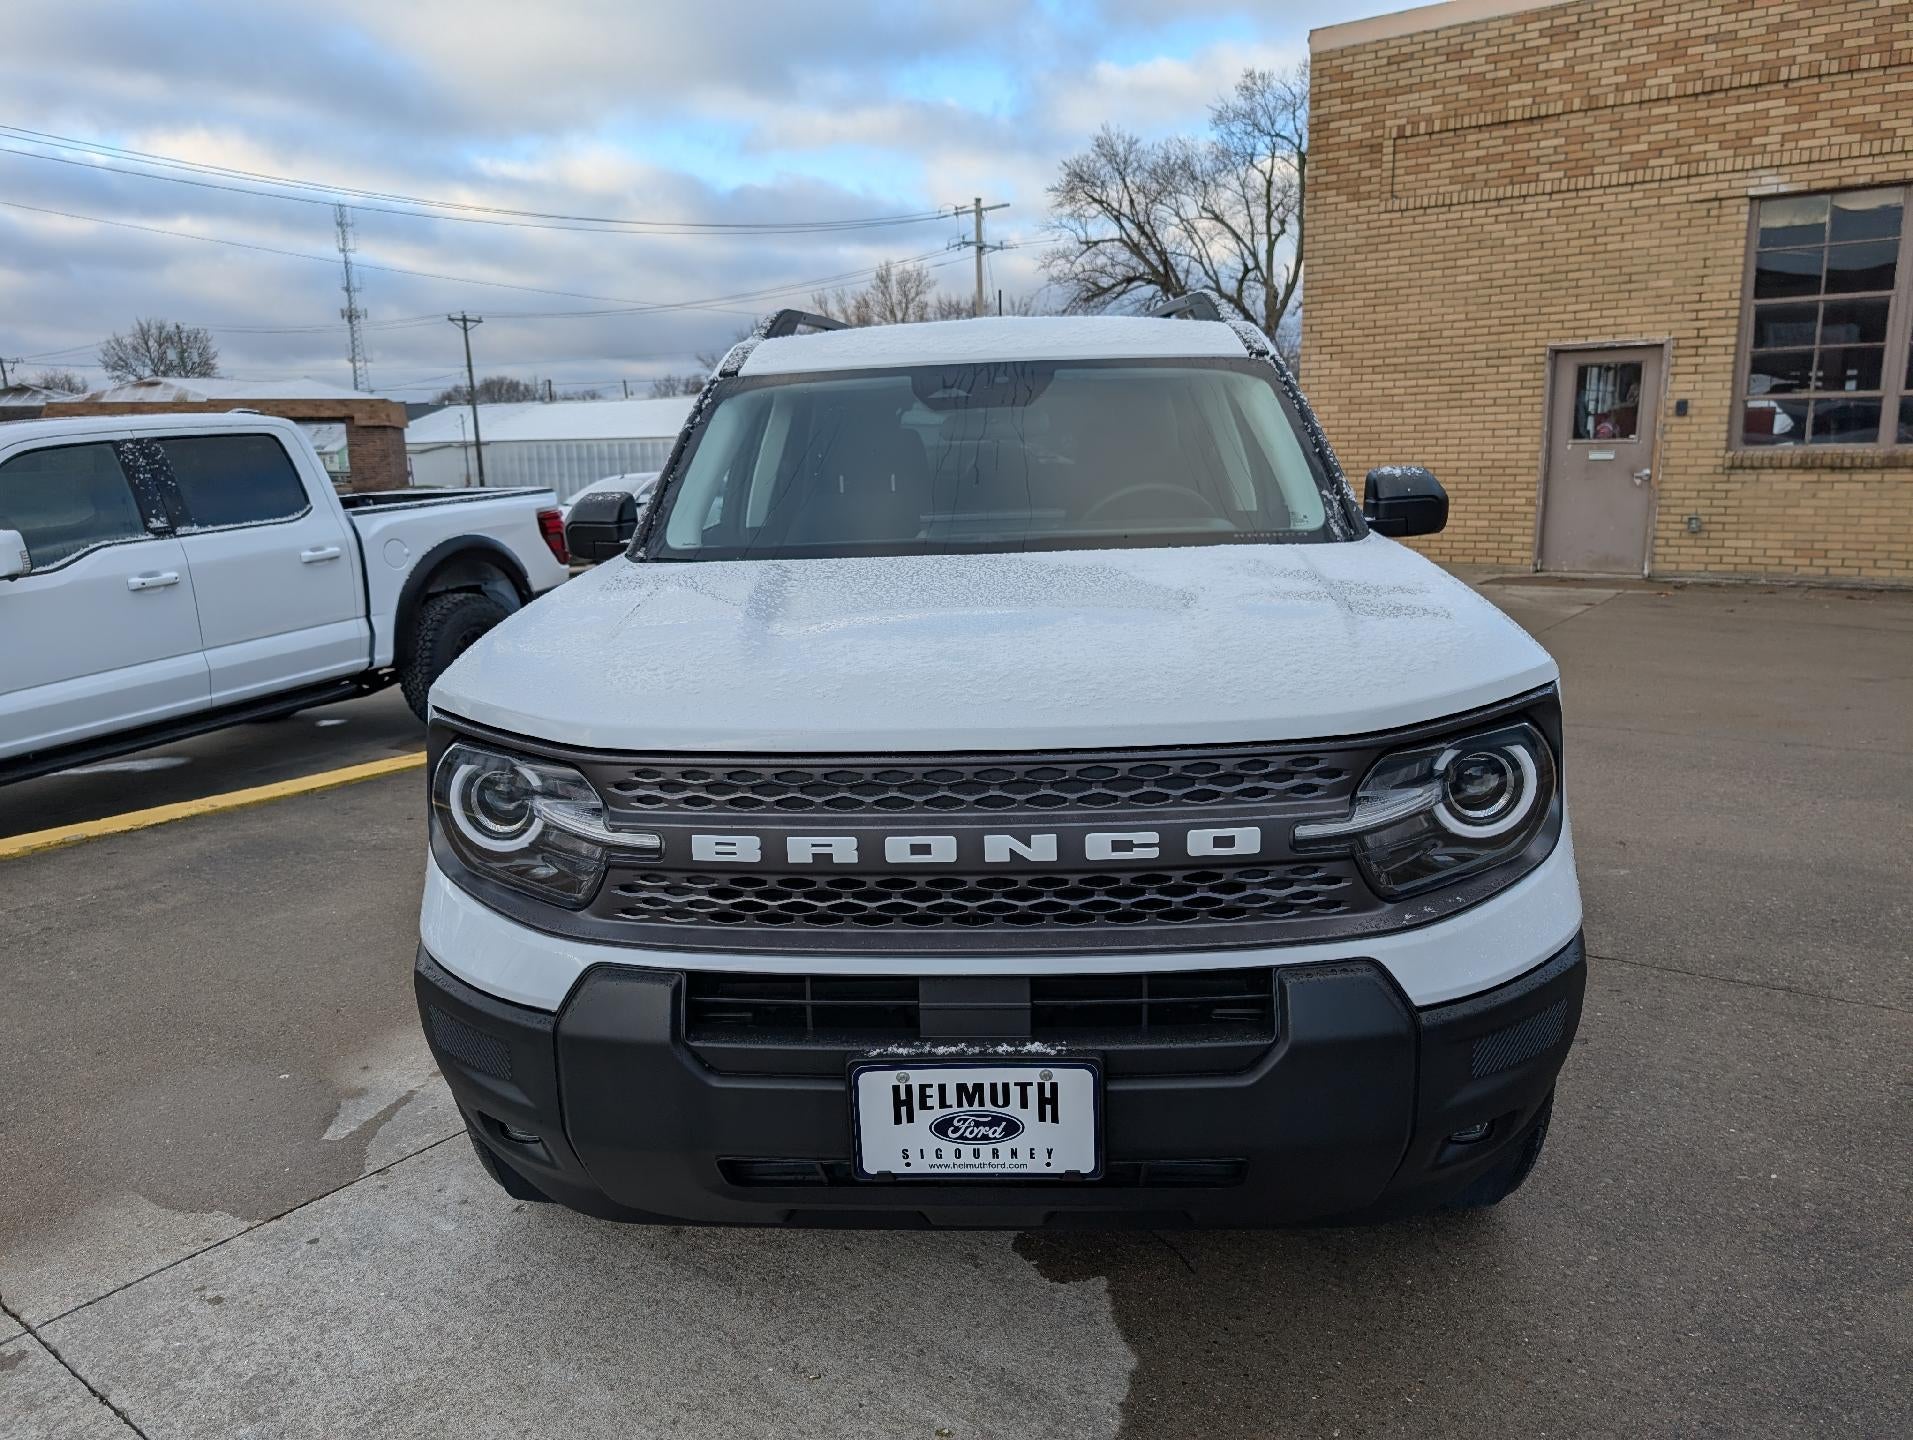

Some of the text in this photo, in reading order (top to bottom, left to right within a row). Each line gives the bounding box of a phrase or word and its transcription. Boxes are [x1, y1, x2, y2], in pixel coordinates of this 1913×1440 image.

[691, 827, 1261, 863] BRONCO
[891, 1081, 1060, 1125] HELMUTH
[947, 1114, 1005, 1139] Ford
[901, 1147, 1054, 1160] SIGOURNEY
[928, 1161, 1028, 1170] www.helmuthford.com
